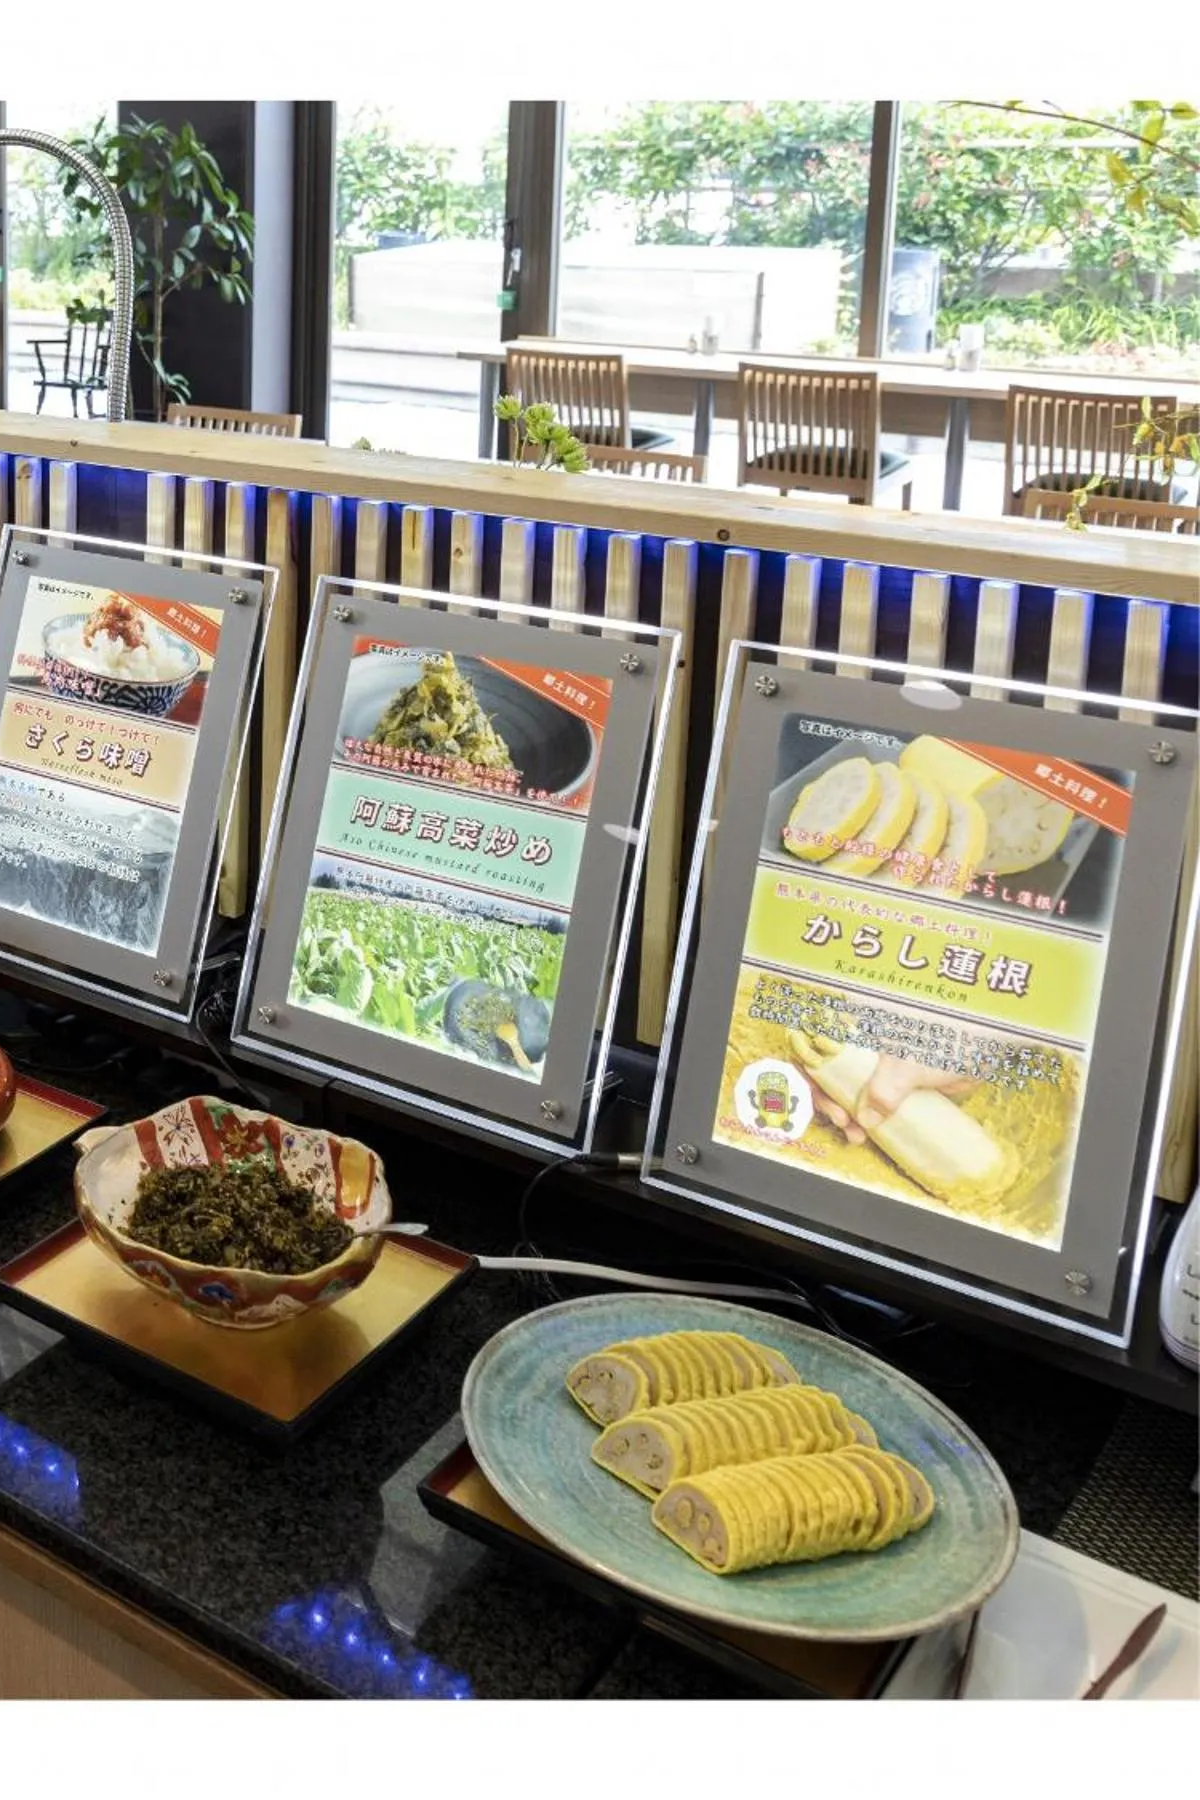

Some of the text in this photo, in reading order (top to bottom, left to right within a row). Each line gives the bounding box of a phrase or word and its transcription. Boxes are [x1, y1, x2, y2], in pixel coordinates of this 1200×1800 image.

[542, 672, 598, 711] 郷土料理!
[25, 724, 150, 775] さくら味噌
[1033, 760, 1109, 811] 郷土料理!
[352, 797, 553, 867] 阿蘇高菜炒め
[339, 831, 545, 892] Aso Chinese mustard roasting
[803, 914, 1030, 995] からし蓮根
[834, 960, 968, 1002] Karashirenkon
